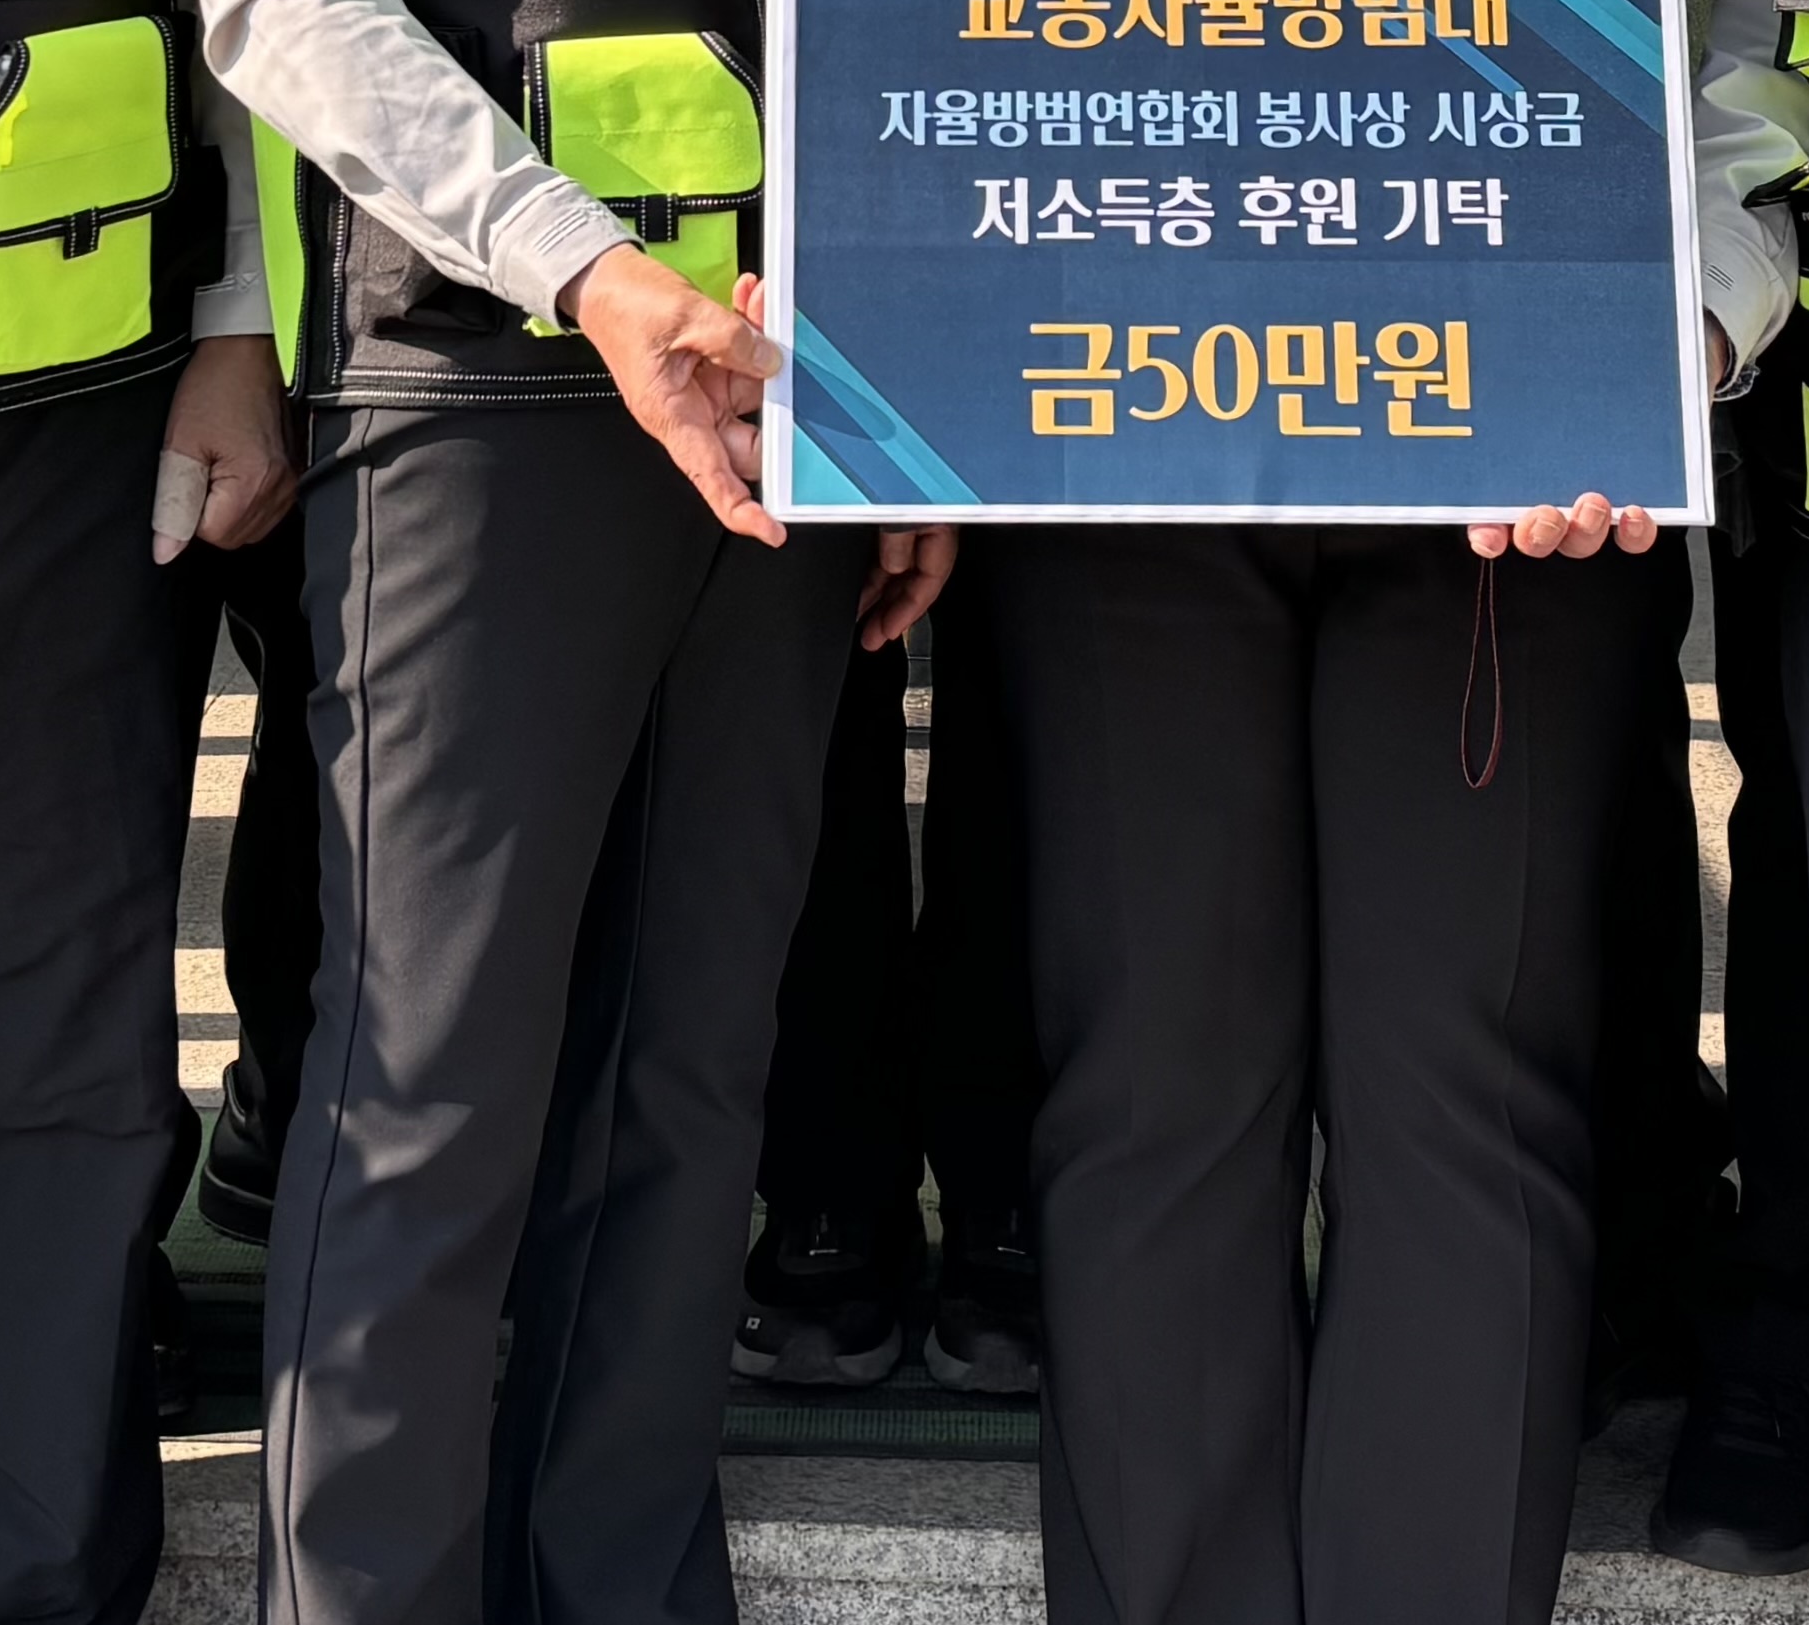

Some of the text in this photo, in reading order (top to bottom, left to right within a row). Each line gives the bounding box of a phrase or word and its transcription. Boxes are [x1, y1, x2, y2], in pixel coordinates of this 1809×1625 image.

[878, 88, 1585, 149] 자율방범연합회 봉사상 시상금
[971, 176, 1510, 247] 저소득층 후원 기탁
[1021, 319, 1474, 436] 금50만원
